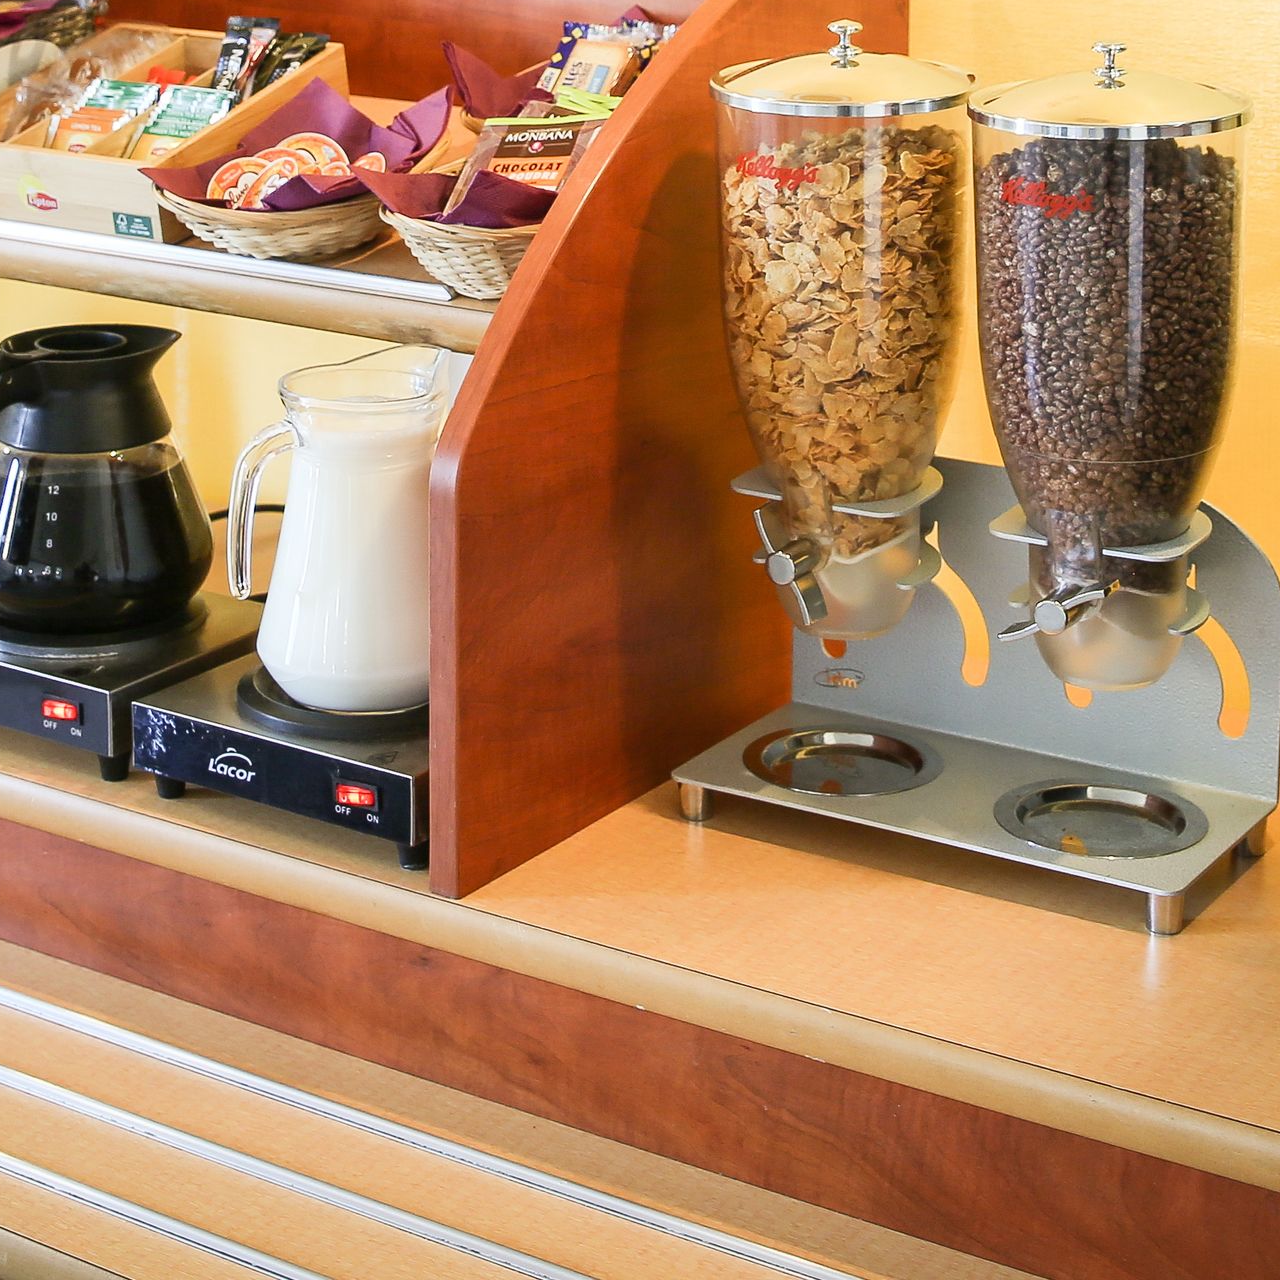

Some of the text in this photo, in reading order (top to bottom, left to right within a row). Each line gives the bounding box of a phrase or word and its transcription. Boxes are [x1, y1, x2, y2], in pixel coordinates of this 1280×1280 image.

[504, 129, 573, 143] MONBANA
[493, 162, 563, 173] CHOCOLAT
[736, 150, 820, 191] Kellogg's
[29, 195, 57, 209] Lipton
[1002, 176, 1097, 221] Kellogg's
[47, 485, 60, 495] 12
[45, 511, 58, 521] 10
[46, 539, 53, 548] 8
[42, 720, 82, 737] OFF ON
[208, 758, 256, 782] Lacor
[334, 804, 379, 824] OFF ON
